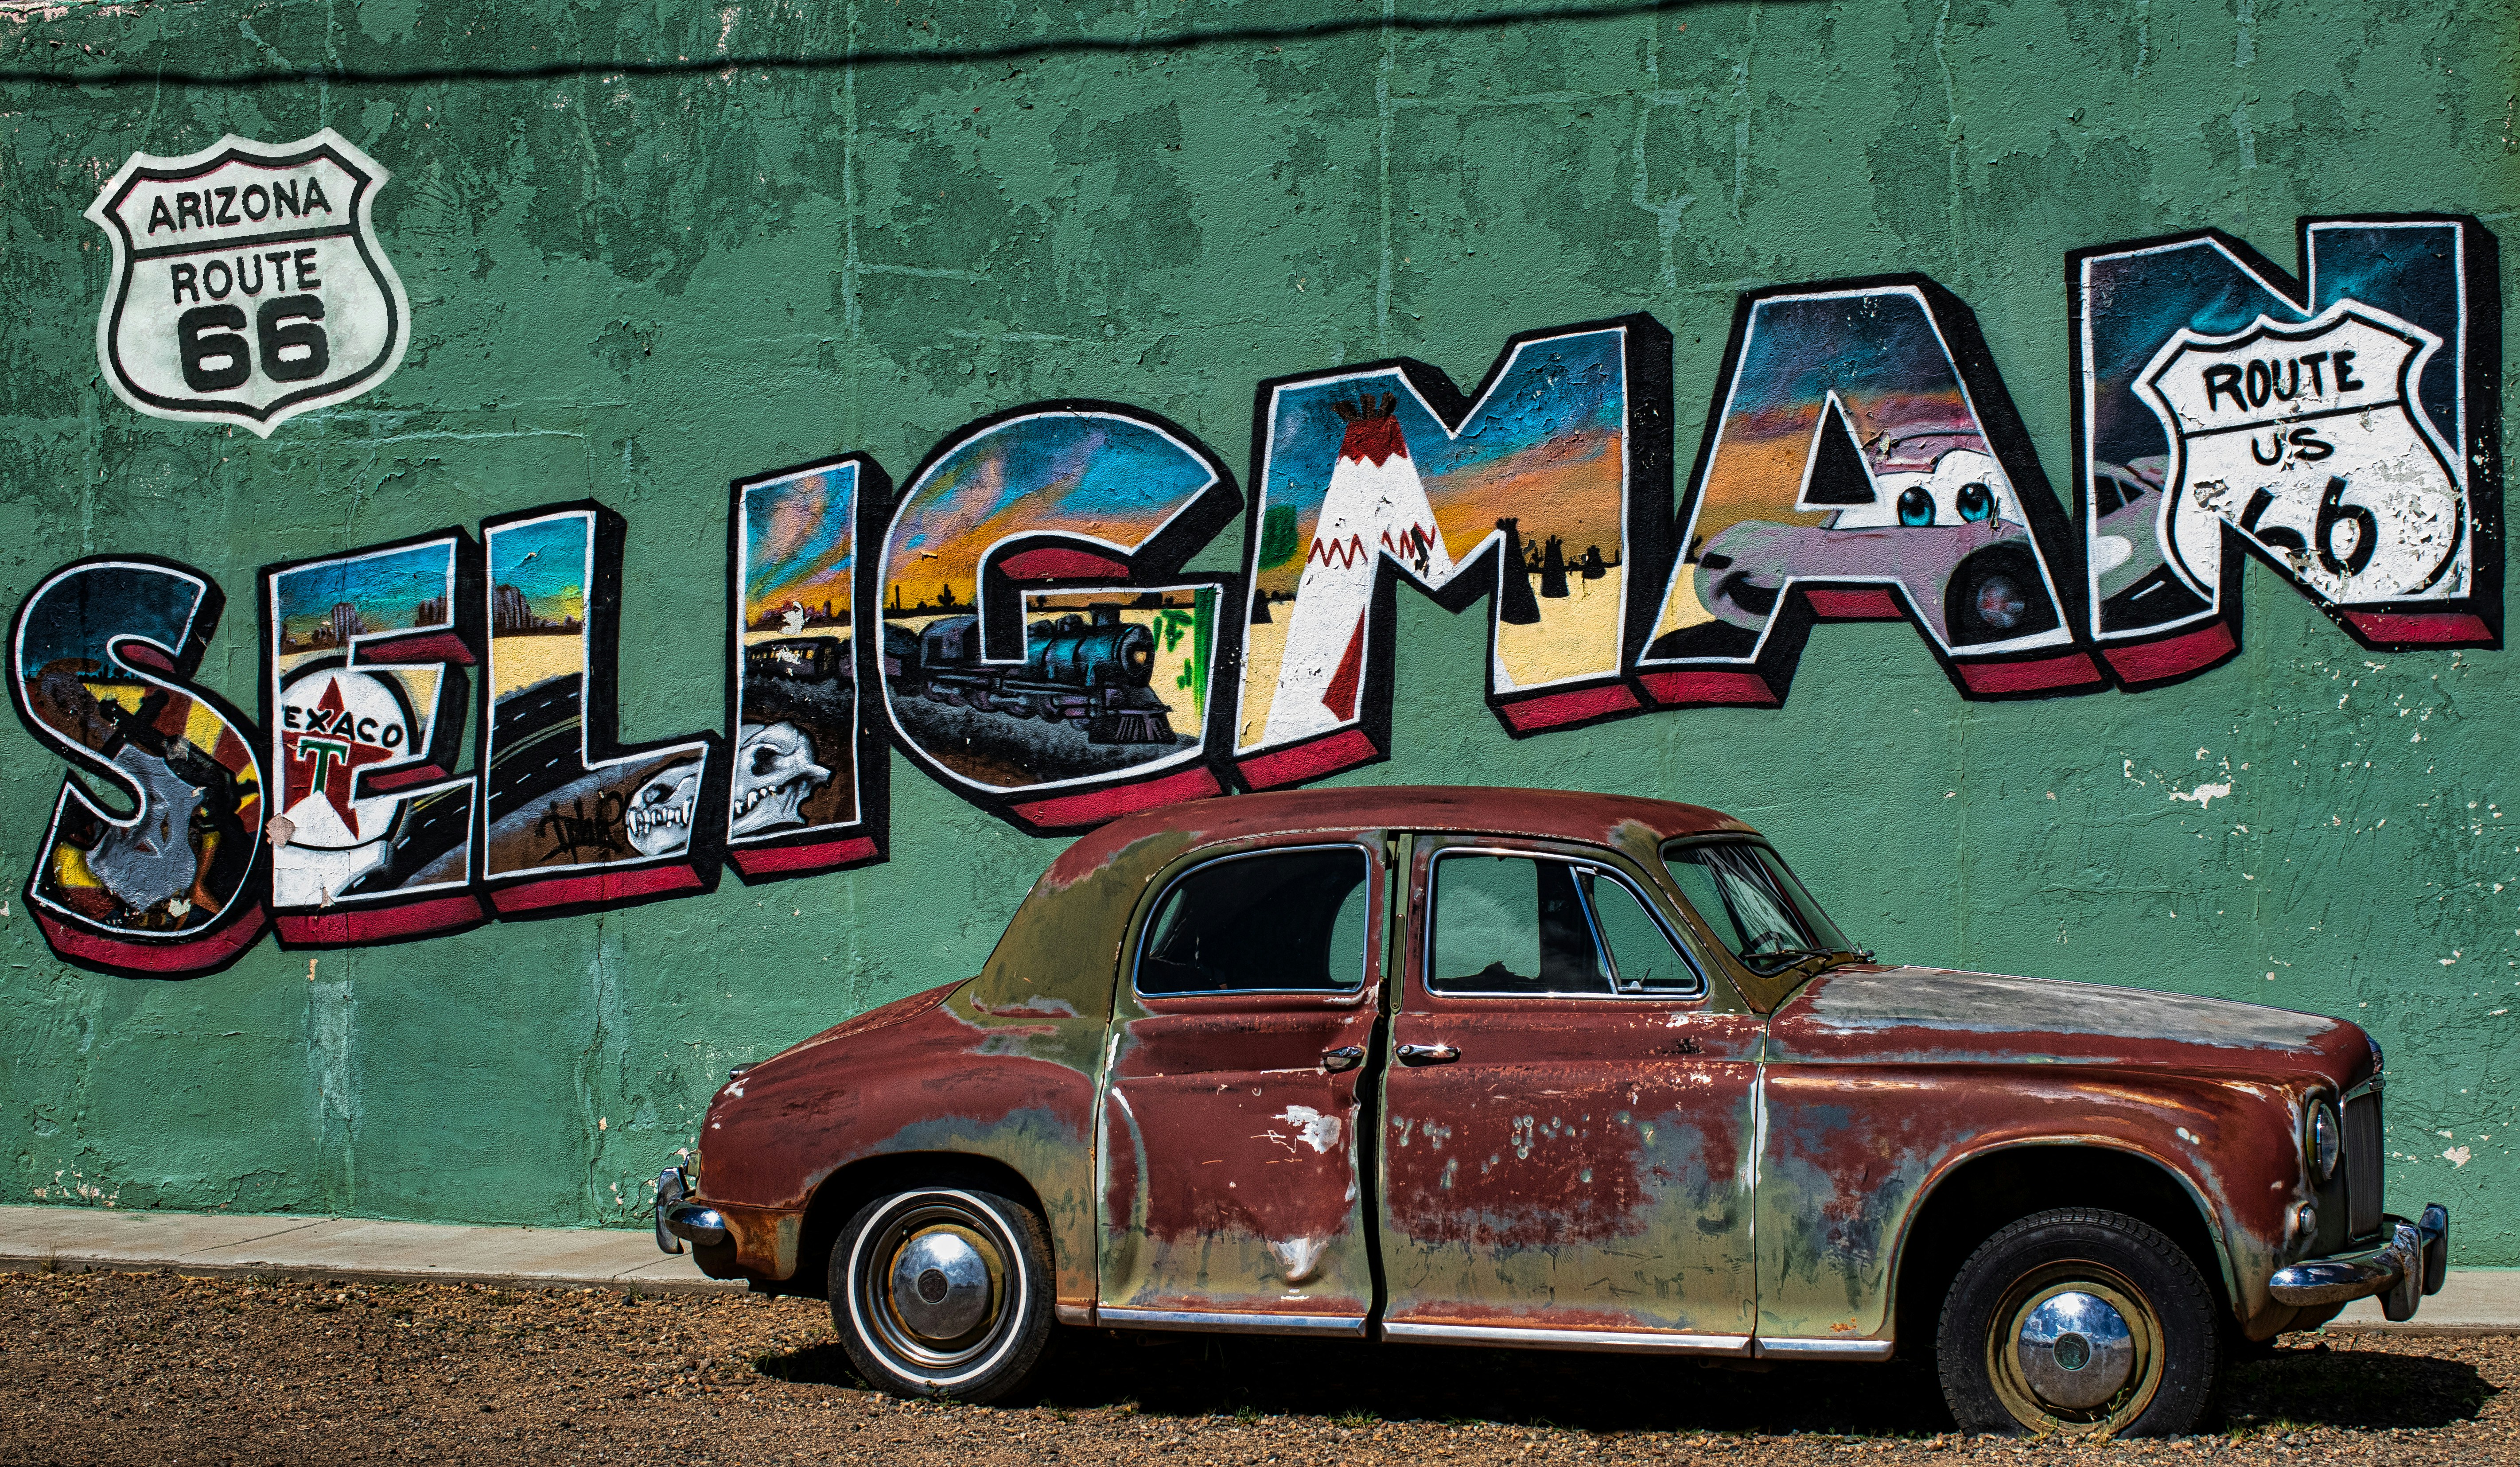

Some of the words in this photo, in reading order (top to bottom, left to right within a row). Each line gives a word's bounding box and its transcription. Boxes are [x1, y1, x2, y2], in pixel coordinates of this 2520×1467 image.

[148, 177, 332, 235] ARIZONA
[171, 247, 321, 305] ROUTE
[178, 293, 329, 393] 66
[2202, 350, 2364, 412] ROUTE
[2252, 427, 2335, 466] US
[7, 215, 2504, 977] SELIGMAN
[282, 704, 404, 748] EXACO
[296, 736, 350, 793] T
